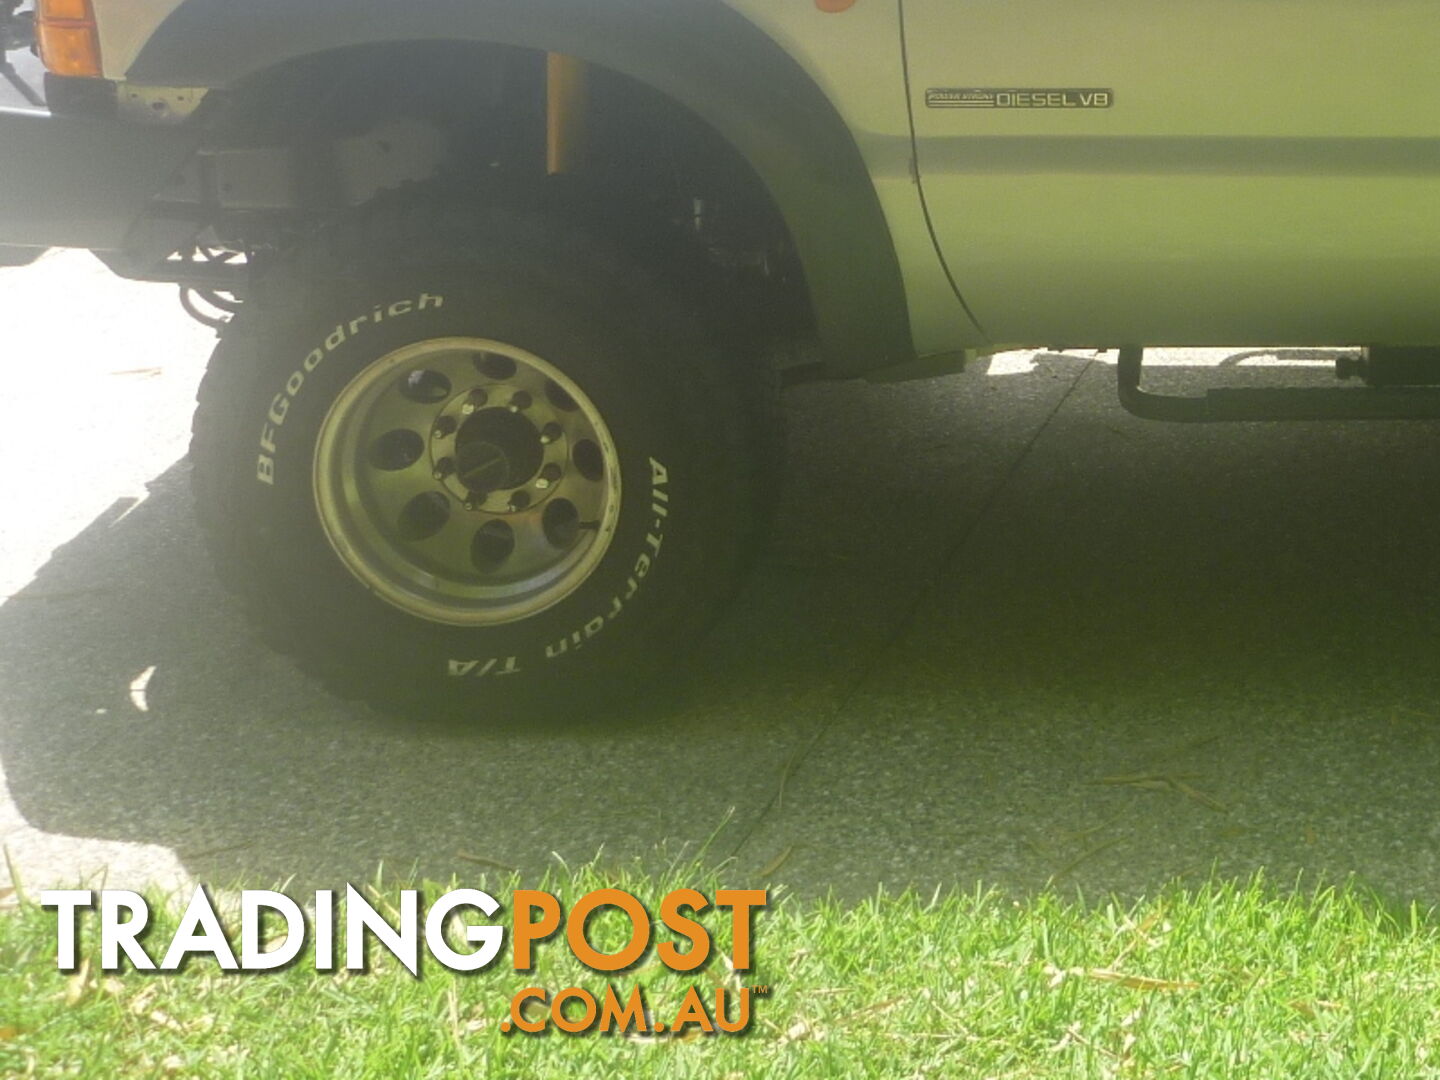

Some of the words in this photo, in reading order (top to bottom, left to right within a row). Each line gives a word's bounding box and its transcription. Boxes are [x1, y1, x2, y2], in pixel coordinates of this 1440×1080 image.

[996, 92, 1076, 107] DIESEL
[1079, 92, 1109, 106] V8
[256, 291, 444, 486] BFGoodrich
[544, 456, 670, 658] All-Terrain
[447, 655, 521, 677] T/A
